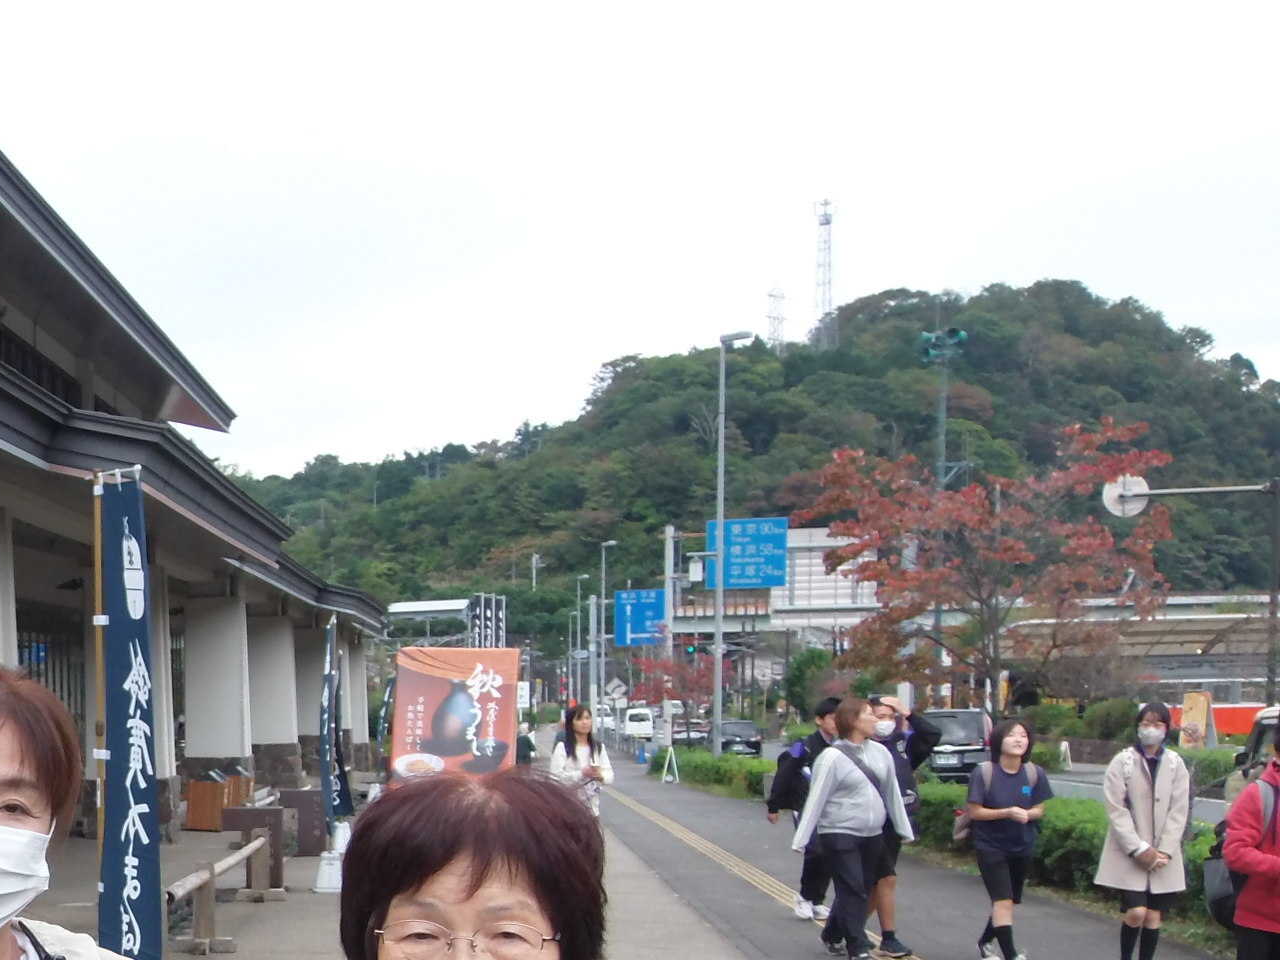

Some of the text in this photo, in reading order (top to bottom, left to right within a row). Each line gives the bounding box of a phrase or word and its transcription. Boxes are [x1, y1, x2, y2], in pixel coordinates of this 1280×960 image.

[731, 523, 757, 535] 東京
[730, 544, 757, 555] 横浜
[730, 565, 756, 576] 平塚
